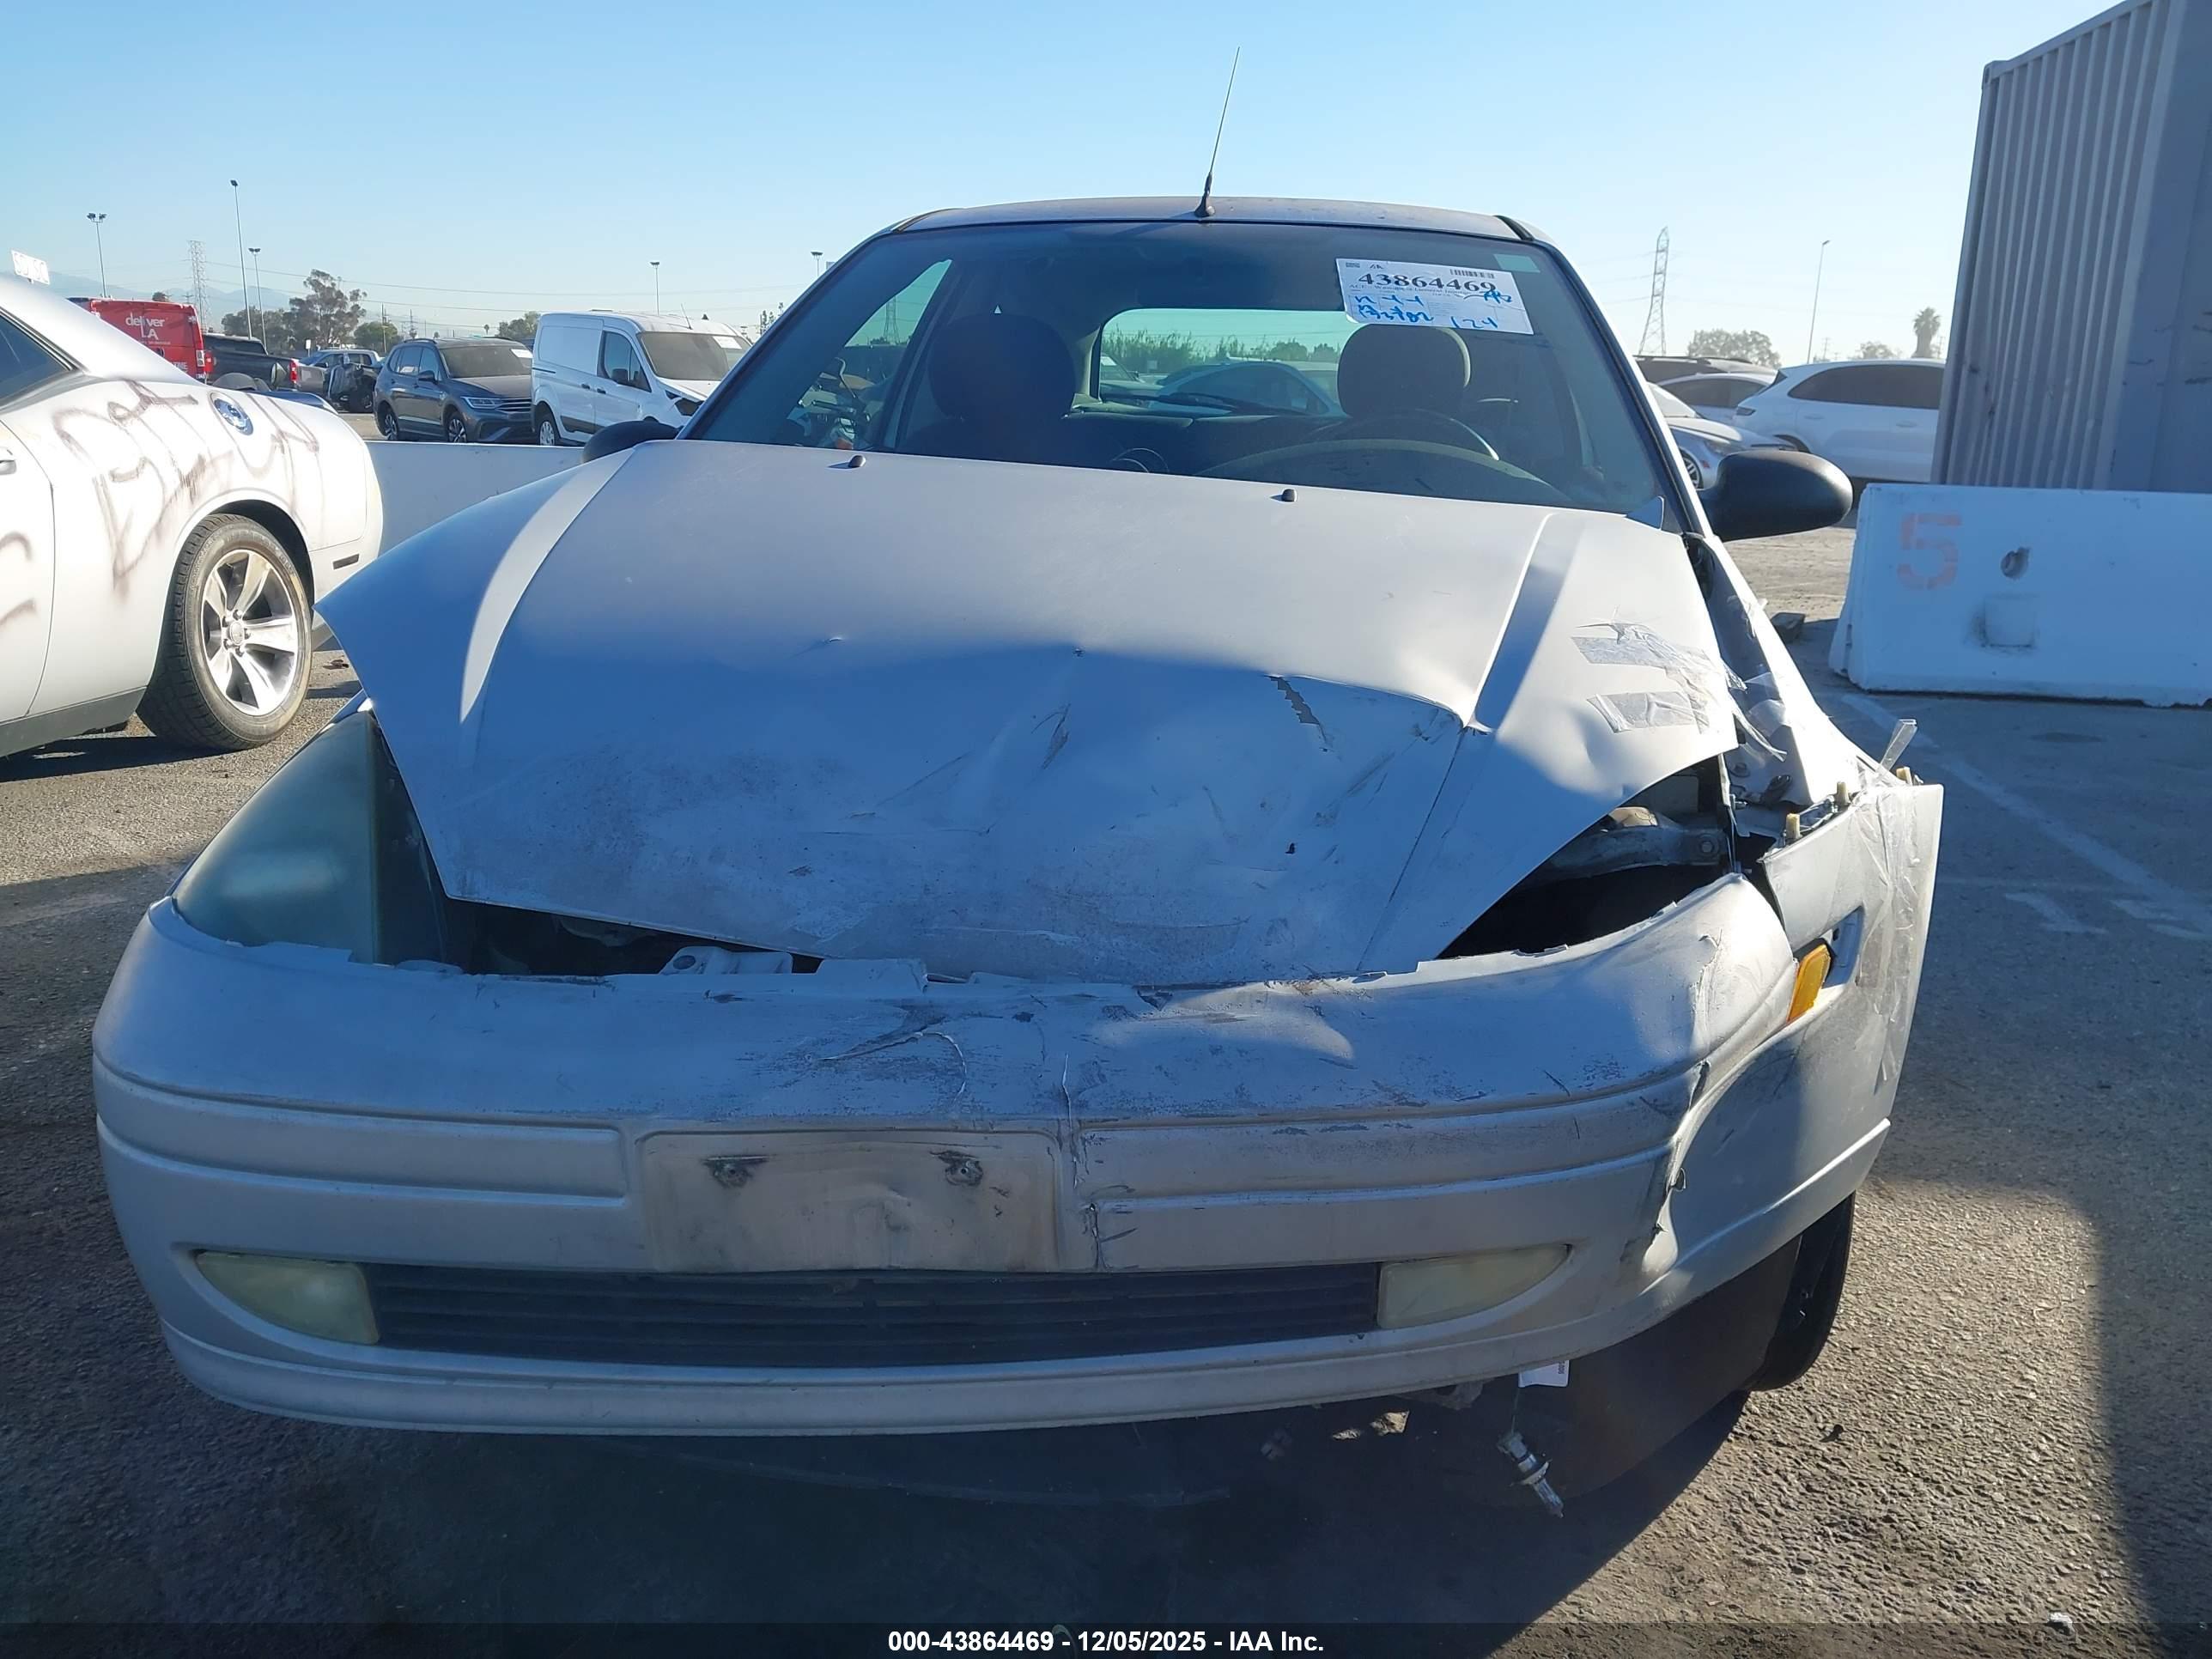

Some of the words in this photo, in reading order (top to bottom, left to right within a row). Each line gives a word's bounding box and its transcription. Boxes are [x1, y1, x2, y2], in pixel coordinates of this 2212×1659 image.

[1358, 272, 1497, 294] 43864469
[125, 311, 165, 327] deliver
[141, 325, 159, 340] LA
[1896, 513, 1962, 591] 5
